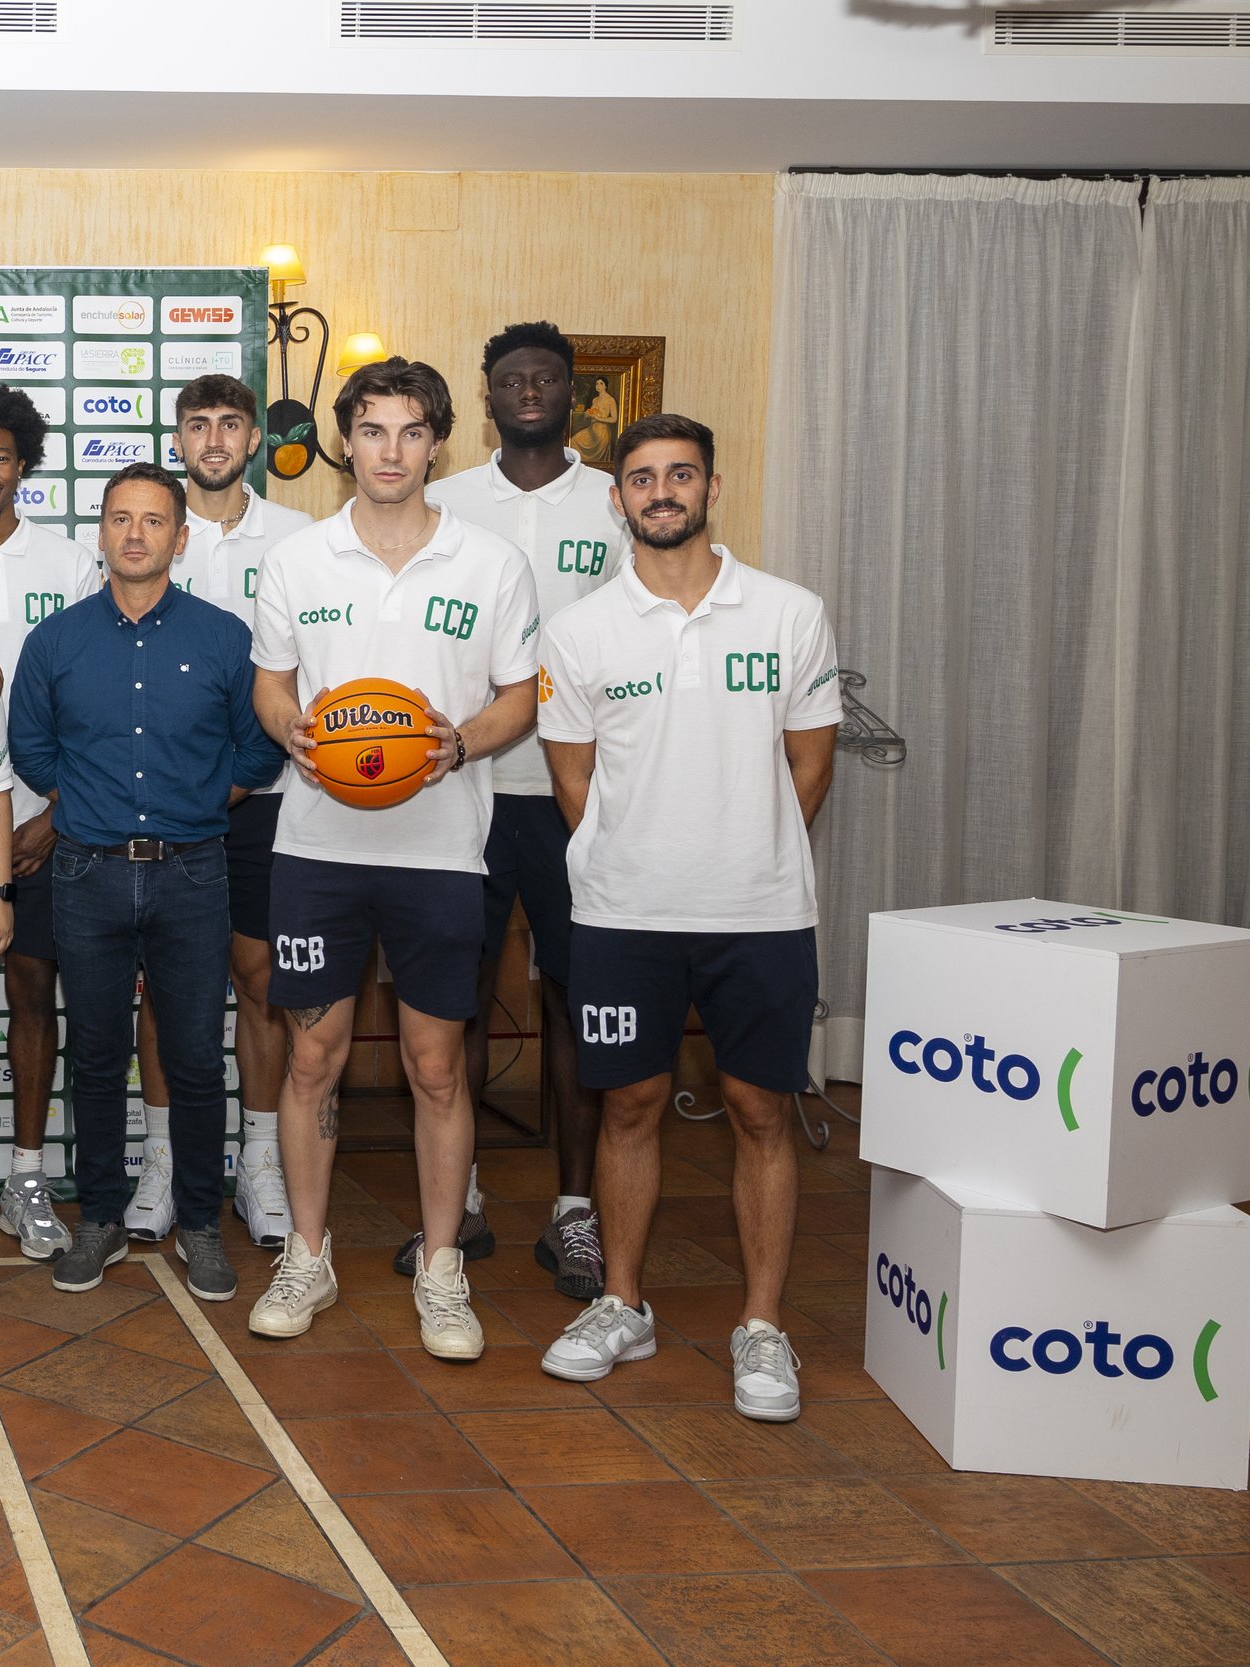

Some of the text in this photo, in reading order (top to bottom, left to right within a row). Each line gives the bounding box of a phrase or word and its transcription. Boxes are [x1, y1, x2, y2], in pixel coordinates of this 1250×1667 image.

[81, 310, 145, 320] enchufesolar
[13, 353, 58, 365] PACC
[168, 355, 208, 365] CLÍNICA
[83, 395, 131, 413] coto
[104, 445, 146, 457] PACC
[557, 539, 607, 577] CCB
[299, 606, 341, 625] coto
[424, 596, 479, 640] CCB
[726, 652, 781, 695] CCB
[605, 680, 652, 701] coto
[323, 704, 414, 733] Wilson
[995, 917, 1122, 933] coto
[276, 934, 325, 973] CCB
[581, 1004, 637, 1047] CCB
[888, 1029, 1040, 1101] coto
[1132, 1051, 1238, 1117] coto
[877, 1252, 931, 1335] coto
[989, 1320, 1174, 1380] coto
